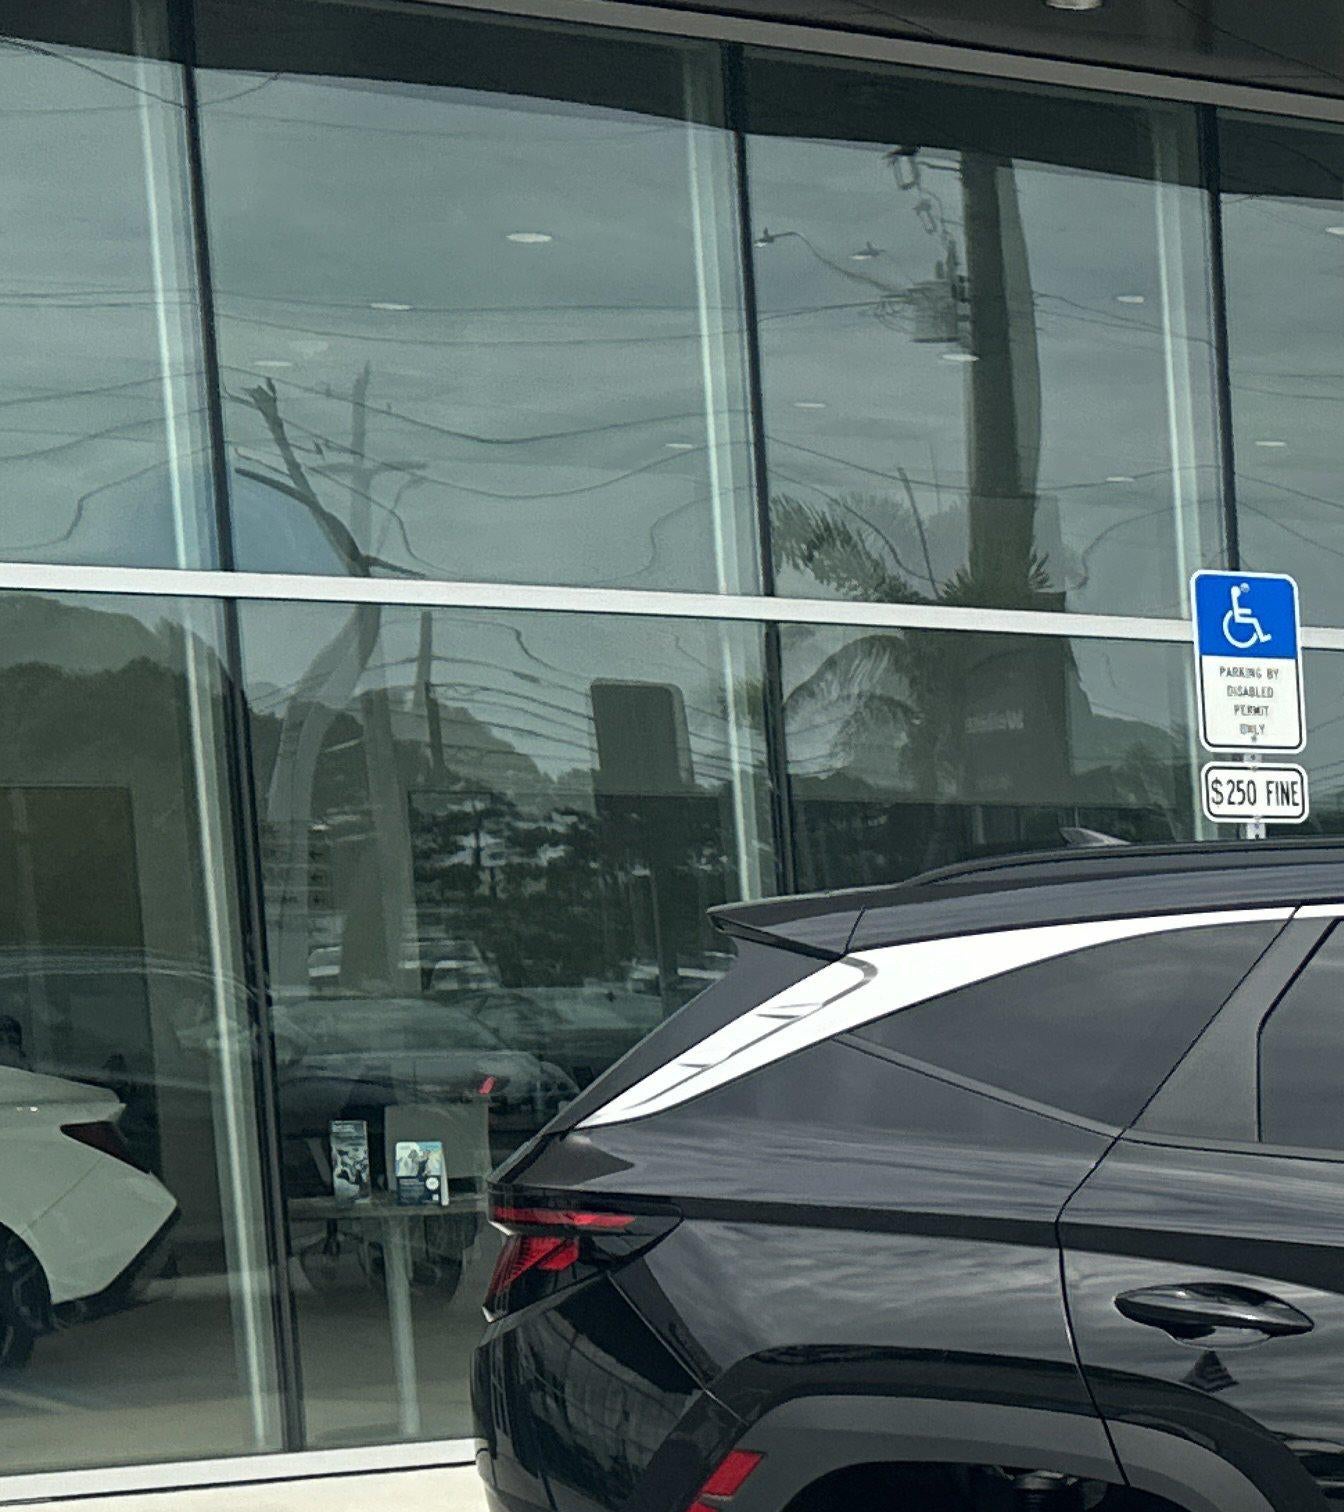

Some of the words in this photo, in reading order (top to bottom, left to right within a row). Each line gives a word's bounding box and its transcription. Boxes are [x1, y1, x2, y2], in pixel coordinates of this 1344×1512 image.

[1219, 666, 1262, 680] PARKING
[1266, 668, 1279, 680] BY
[1227, 685, 1273, 698] DISABLED
[1234, 704, 1269, 717] PERMIT
[1211, 777, 1257, 808] $250
[1266, 780, 1300, 806] FINE
